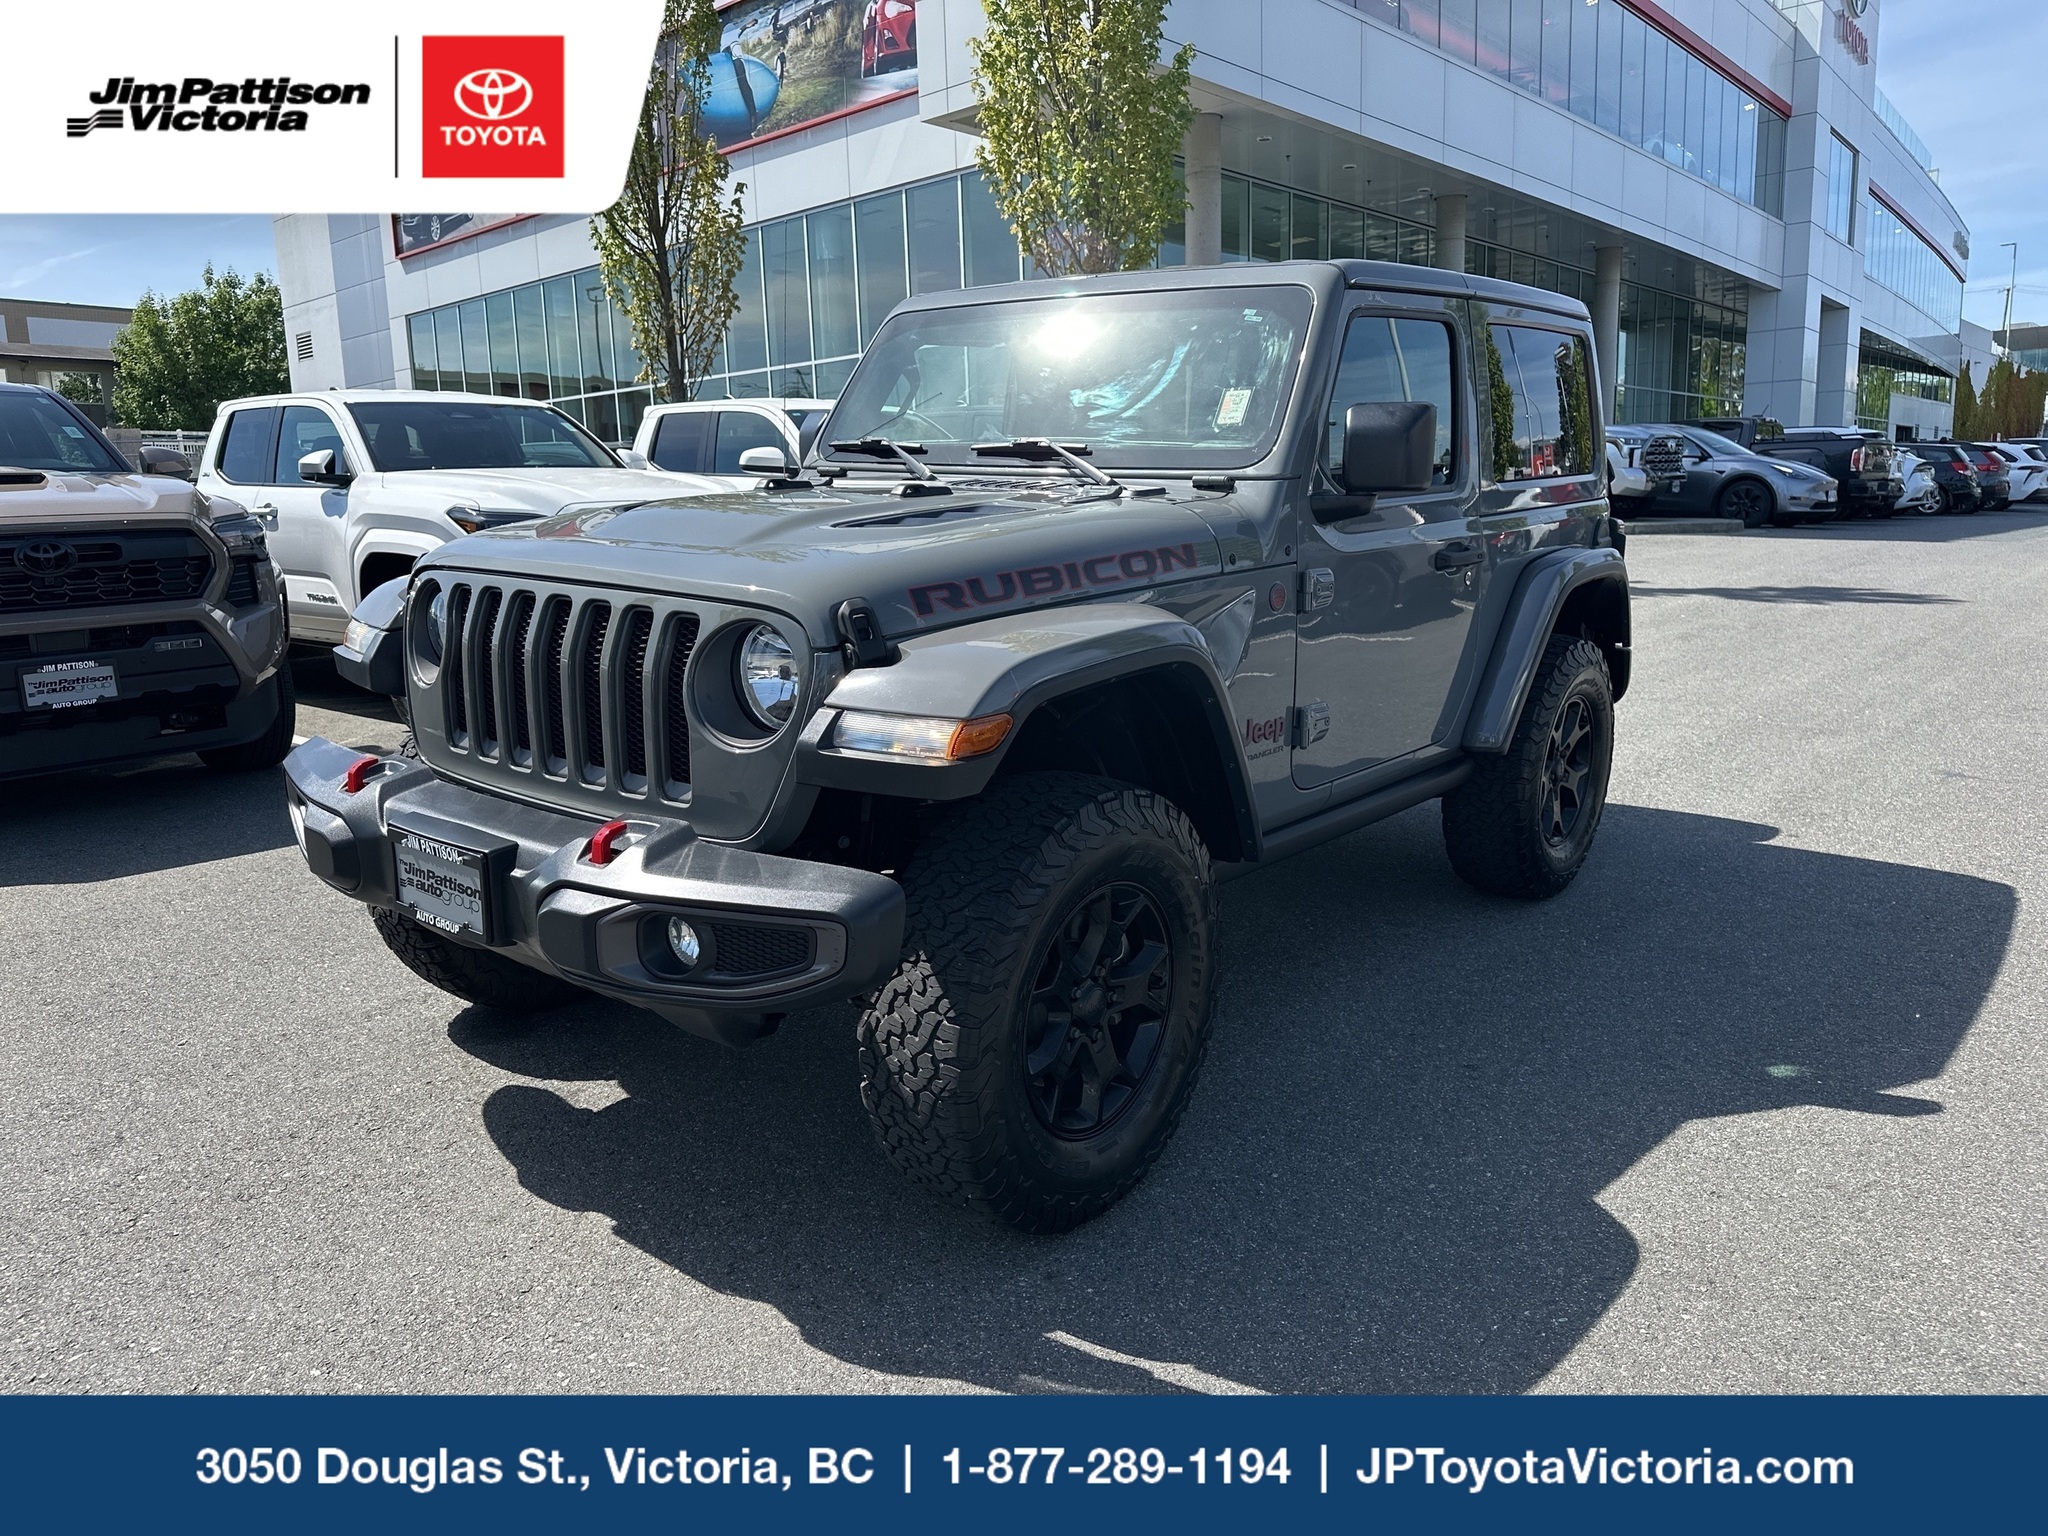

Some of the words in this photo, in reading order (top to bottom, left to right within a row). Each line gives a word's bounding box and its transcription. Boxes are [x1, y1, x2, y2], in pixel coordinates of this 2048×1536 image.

[908, 543, 1198, 618] RUBICON
[41, 664, 56, 673] JIM
[57, 660, 95, 671] PATTISON
[52, 701, 72, 709] AUTO
[72, 698, 97, 707] GROUP
[1242, 716, 1285, 747] Jeep
[1246, 745, 1284, 761] RANGLER
[407, 835, 421, 850] JIM
[421, 839, 461, 864] PATTISON
[416, 910, 435, 925] AUTO
[435, 917, 460, 934] GROUP
